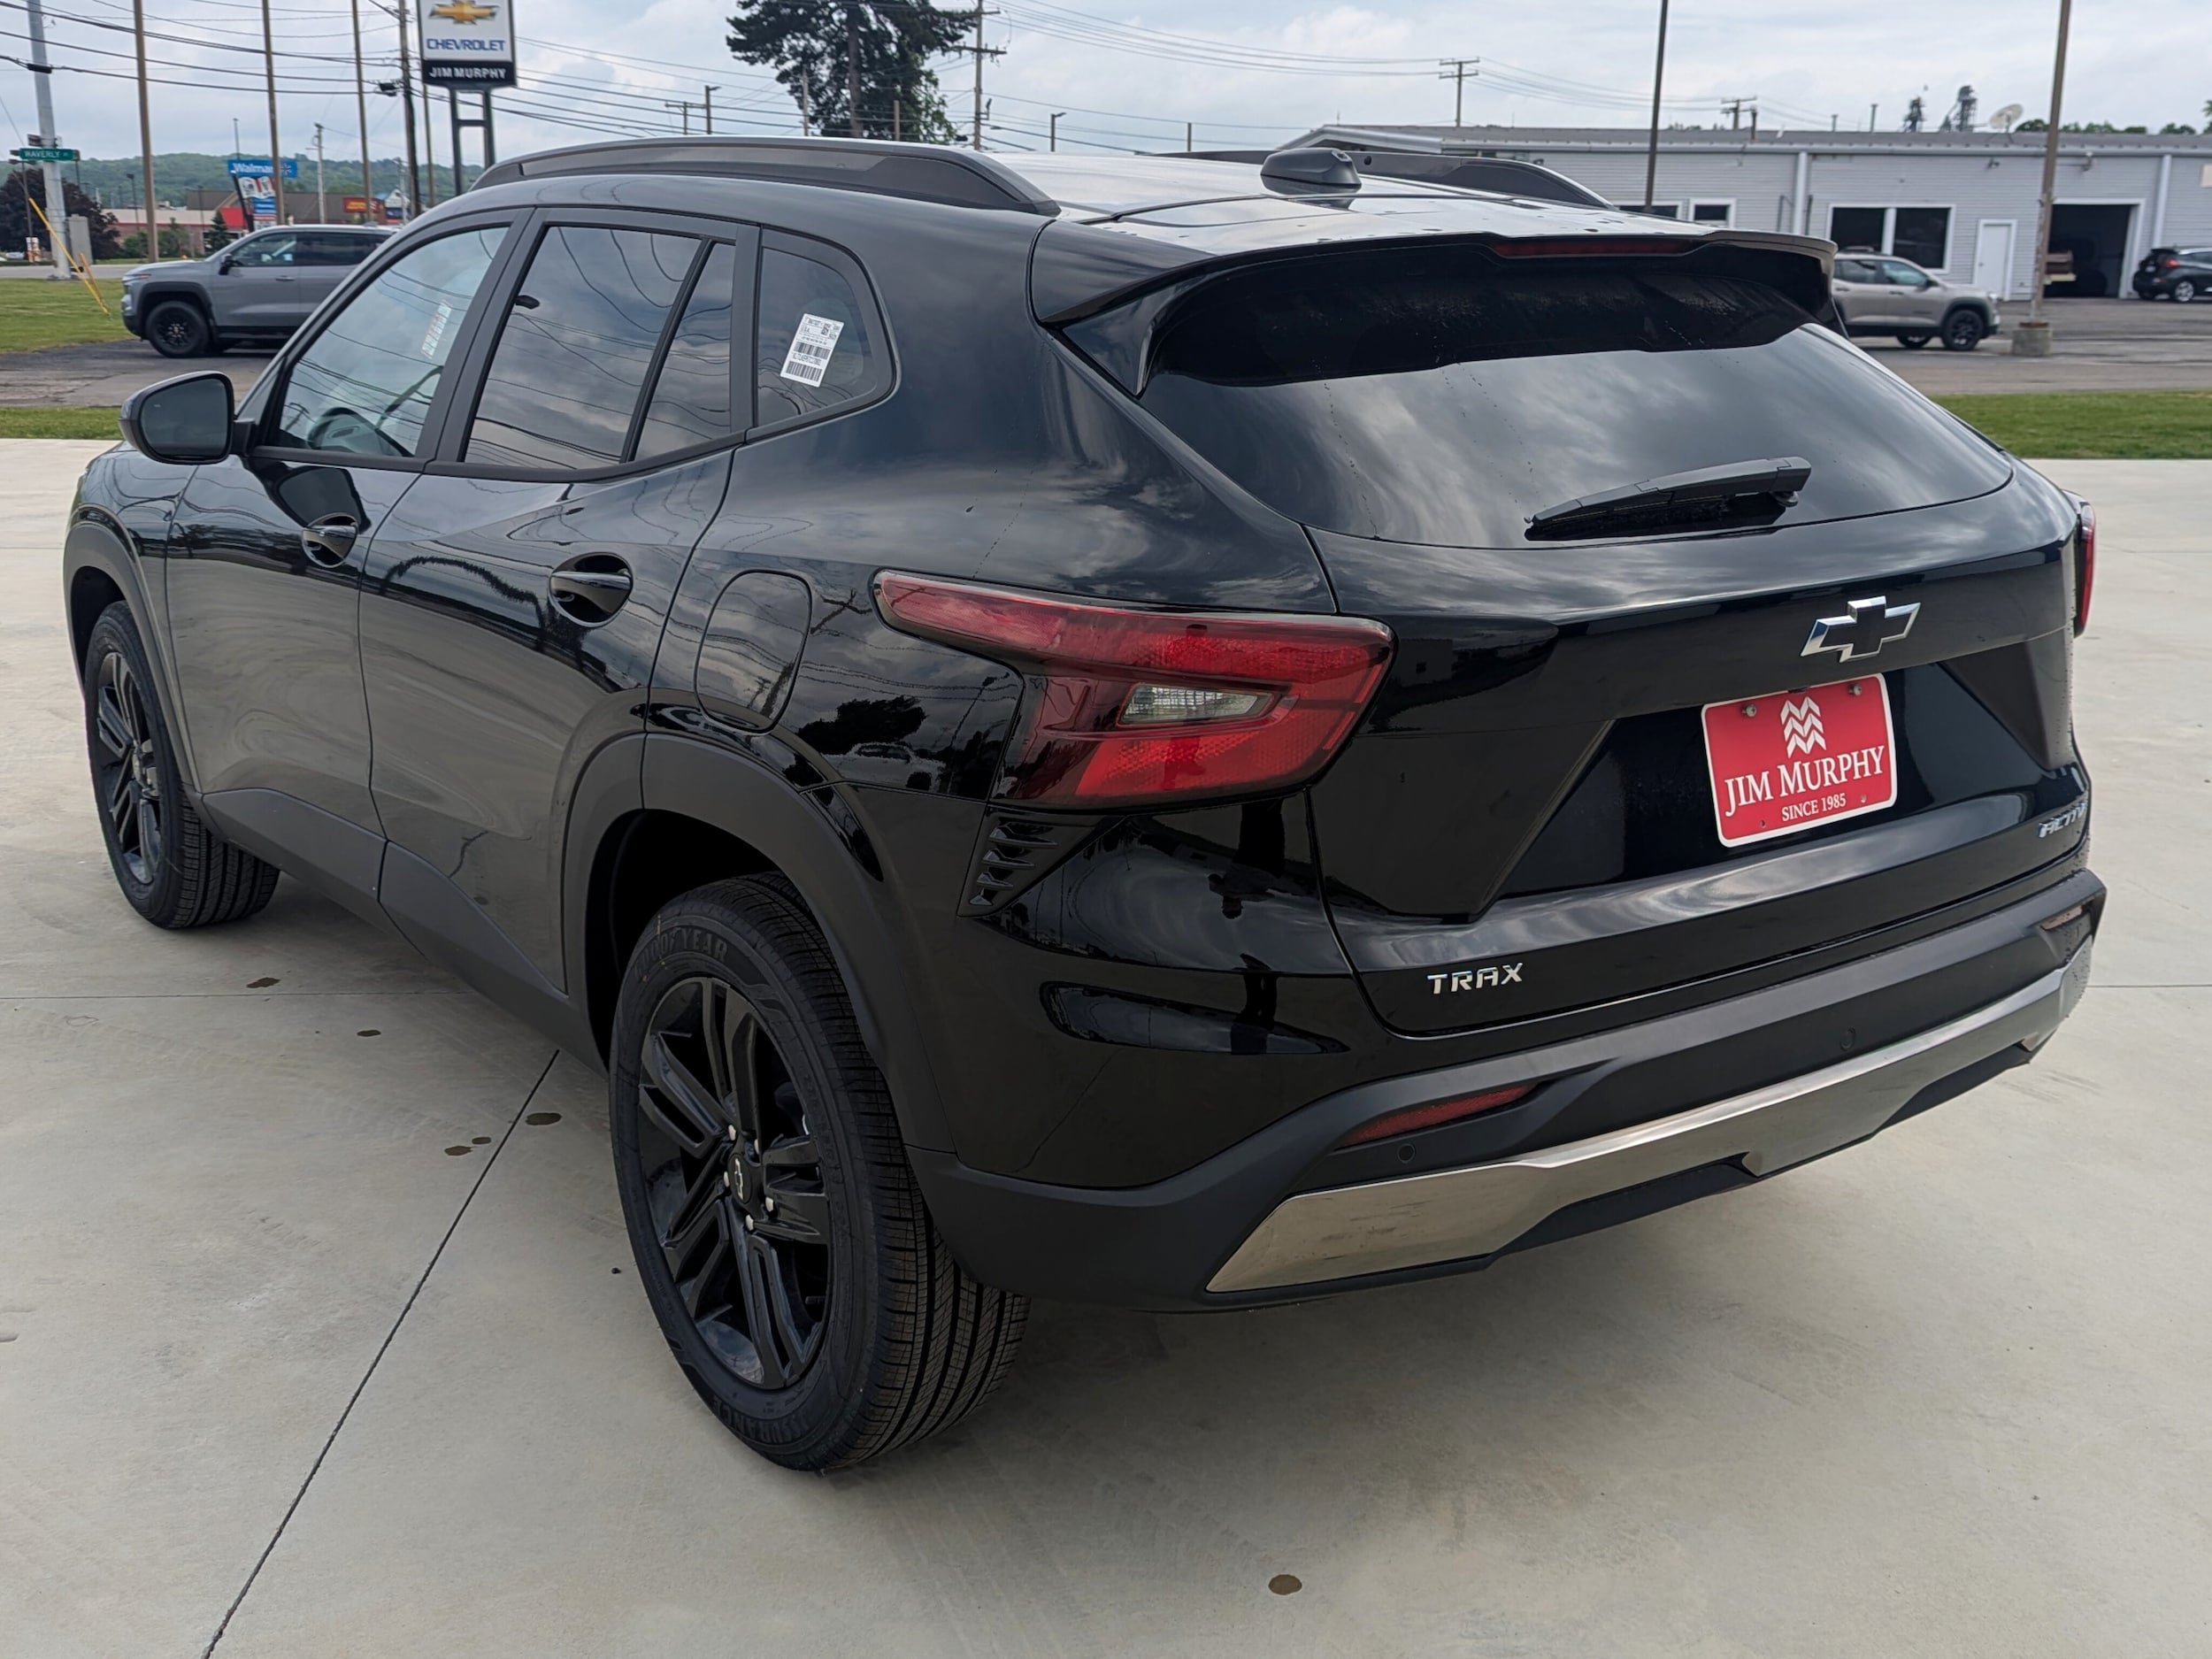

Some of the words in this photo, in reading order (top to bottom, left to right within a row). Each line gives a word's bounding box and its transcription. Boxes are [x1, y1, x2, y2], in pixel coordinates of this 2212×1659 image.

[426, 38, 505, 50] CHEVROLET
[429, 66, 453, 78] JIM
[453, 67, 506, 79] MURPHY
[233, 163, 273, 173] Walma
[1724, 771, 1773, 817] JIM
[1782, 800, 1818, 821] SINCE
[1821, 793, 1847, 811] 1985
[1427, 963, 1523, 995] TRAX
